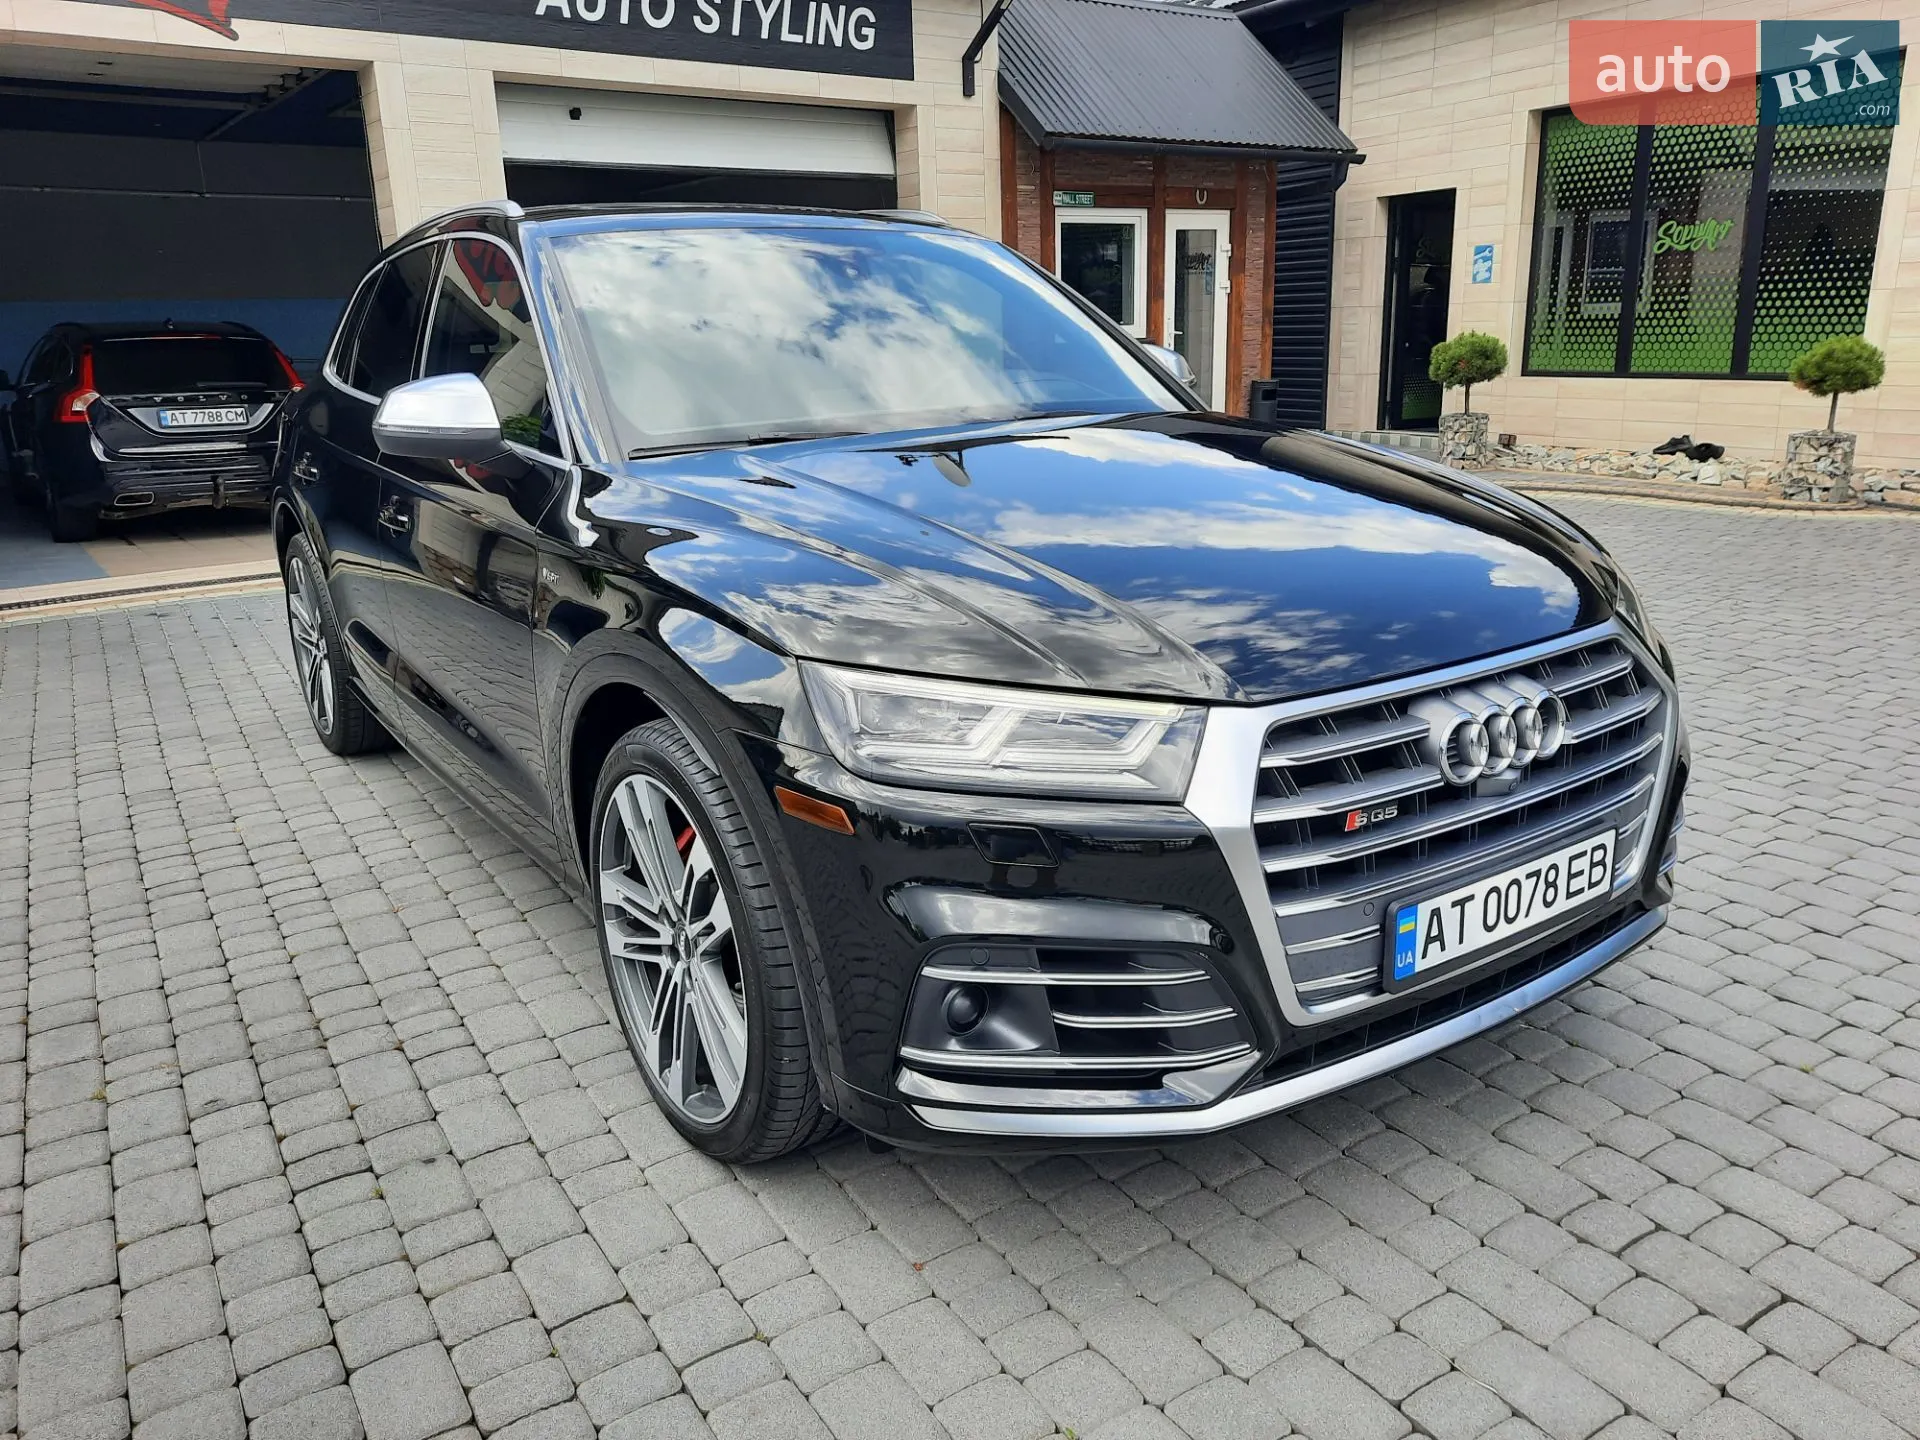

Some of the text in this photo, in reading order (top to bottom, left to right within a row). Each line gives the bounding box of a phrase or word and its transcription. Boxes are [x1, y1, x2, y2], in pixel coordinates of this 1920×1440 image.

[693, 0, 877, 51] STYLING
[153, 394, 248, 402] VOLVO
[170, 410, 246, 424] AT 7788 CM
[1354, 805, 1398, 828] SQ5
[1420, 842, 1608, 960] AT 0078 EB
[1397, 952, 1414, 968] UA
